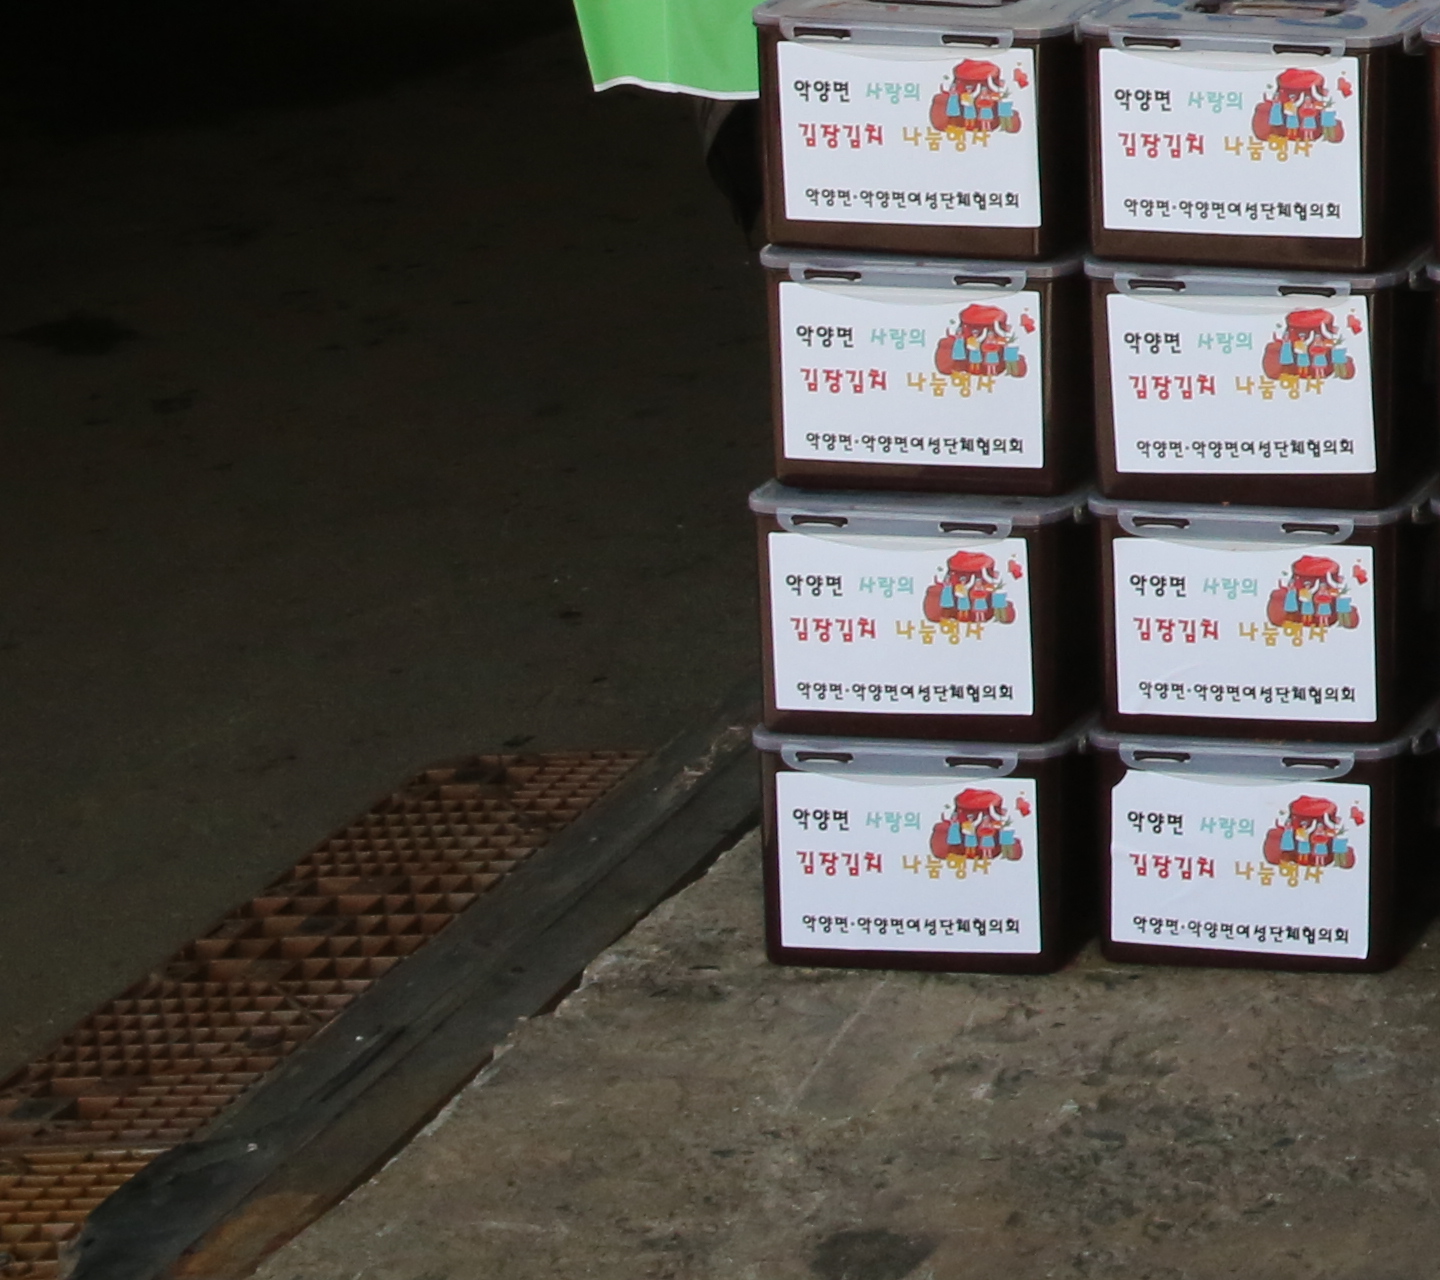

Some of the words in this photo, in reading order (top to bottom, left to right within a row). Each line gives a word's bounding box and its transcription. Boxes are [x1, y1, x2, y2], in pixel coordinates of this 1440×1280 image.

[793, 79, 851, 103] 악양면
[865, 80, 923, 102] 사랑의
[798, 123, 884, 149] 김장김치
[902, 124, 991, 150] 나눔행사
[1123, 332, 1182, 355] 악양면
[1197, 329, 1255, 353] 사랑의
[1128, 373, 1216, 401] 김장김치
[1235, 371, 1325, 400] 나눔행사
[785, 574, 843, 597] 악양면
[858, 572, 916, 596] 사랑의
[790, 617, 876, 643] 김장김치
[895, 616, 985, 643] 나눔행사
[1127, 810, 1184, 836] 악양면
[1199, 813, 1258, 837] 사랑의
[1129, 853, 1215, 881] 김장김치
[1234, 858, 1324, 886] 나눔행사
